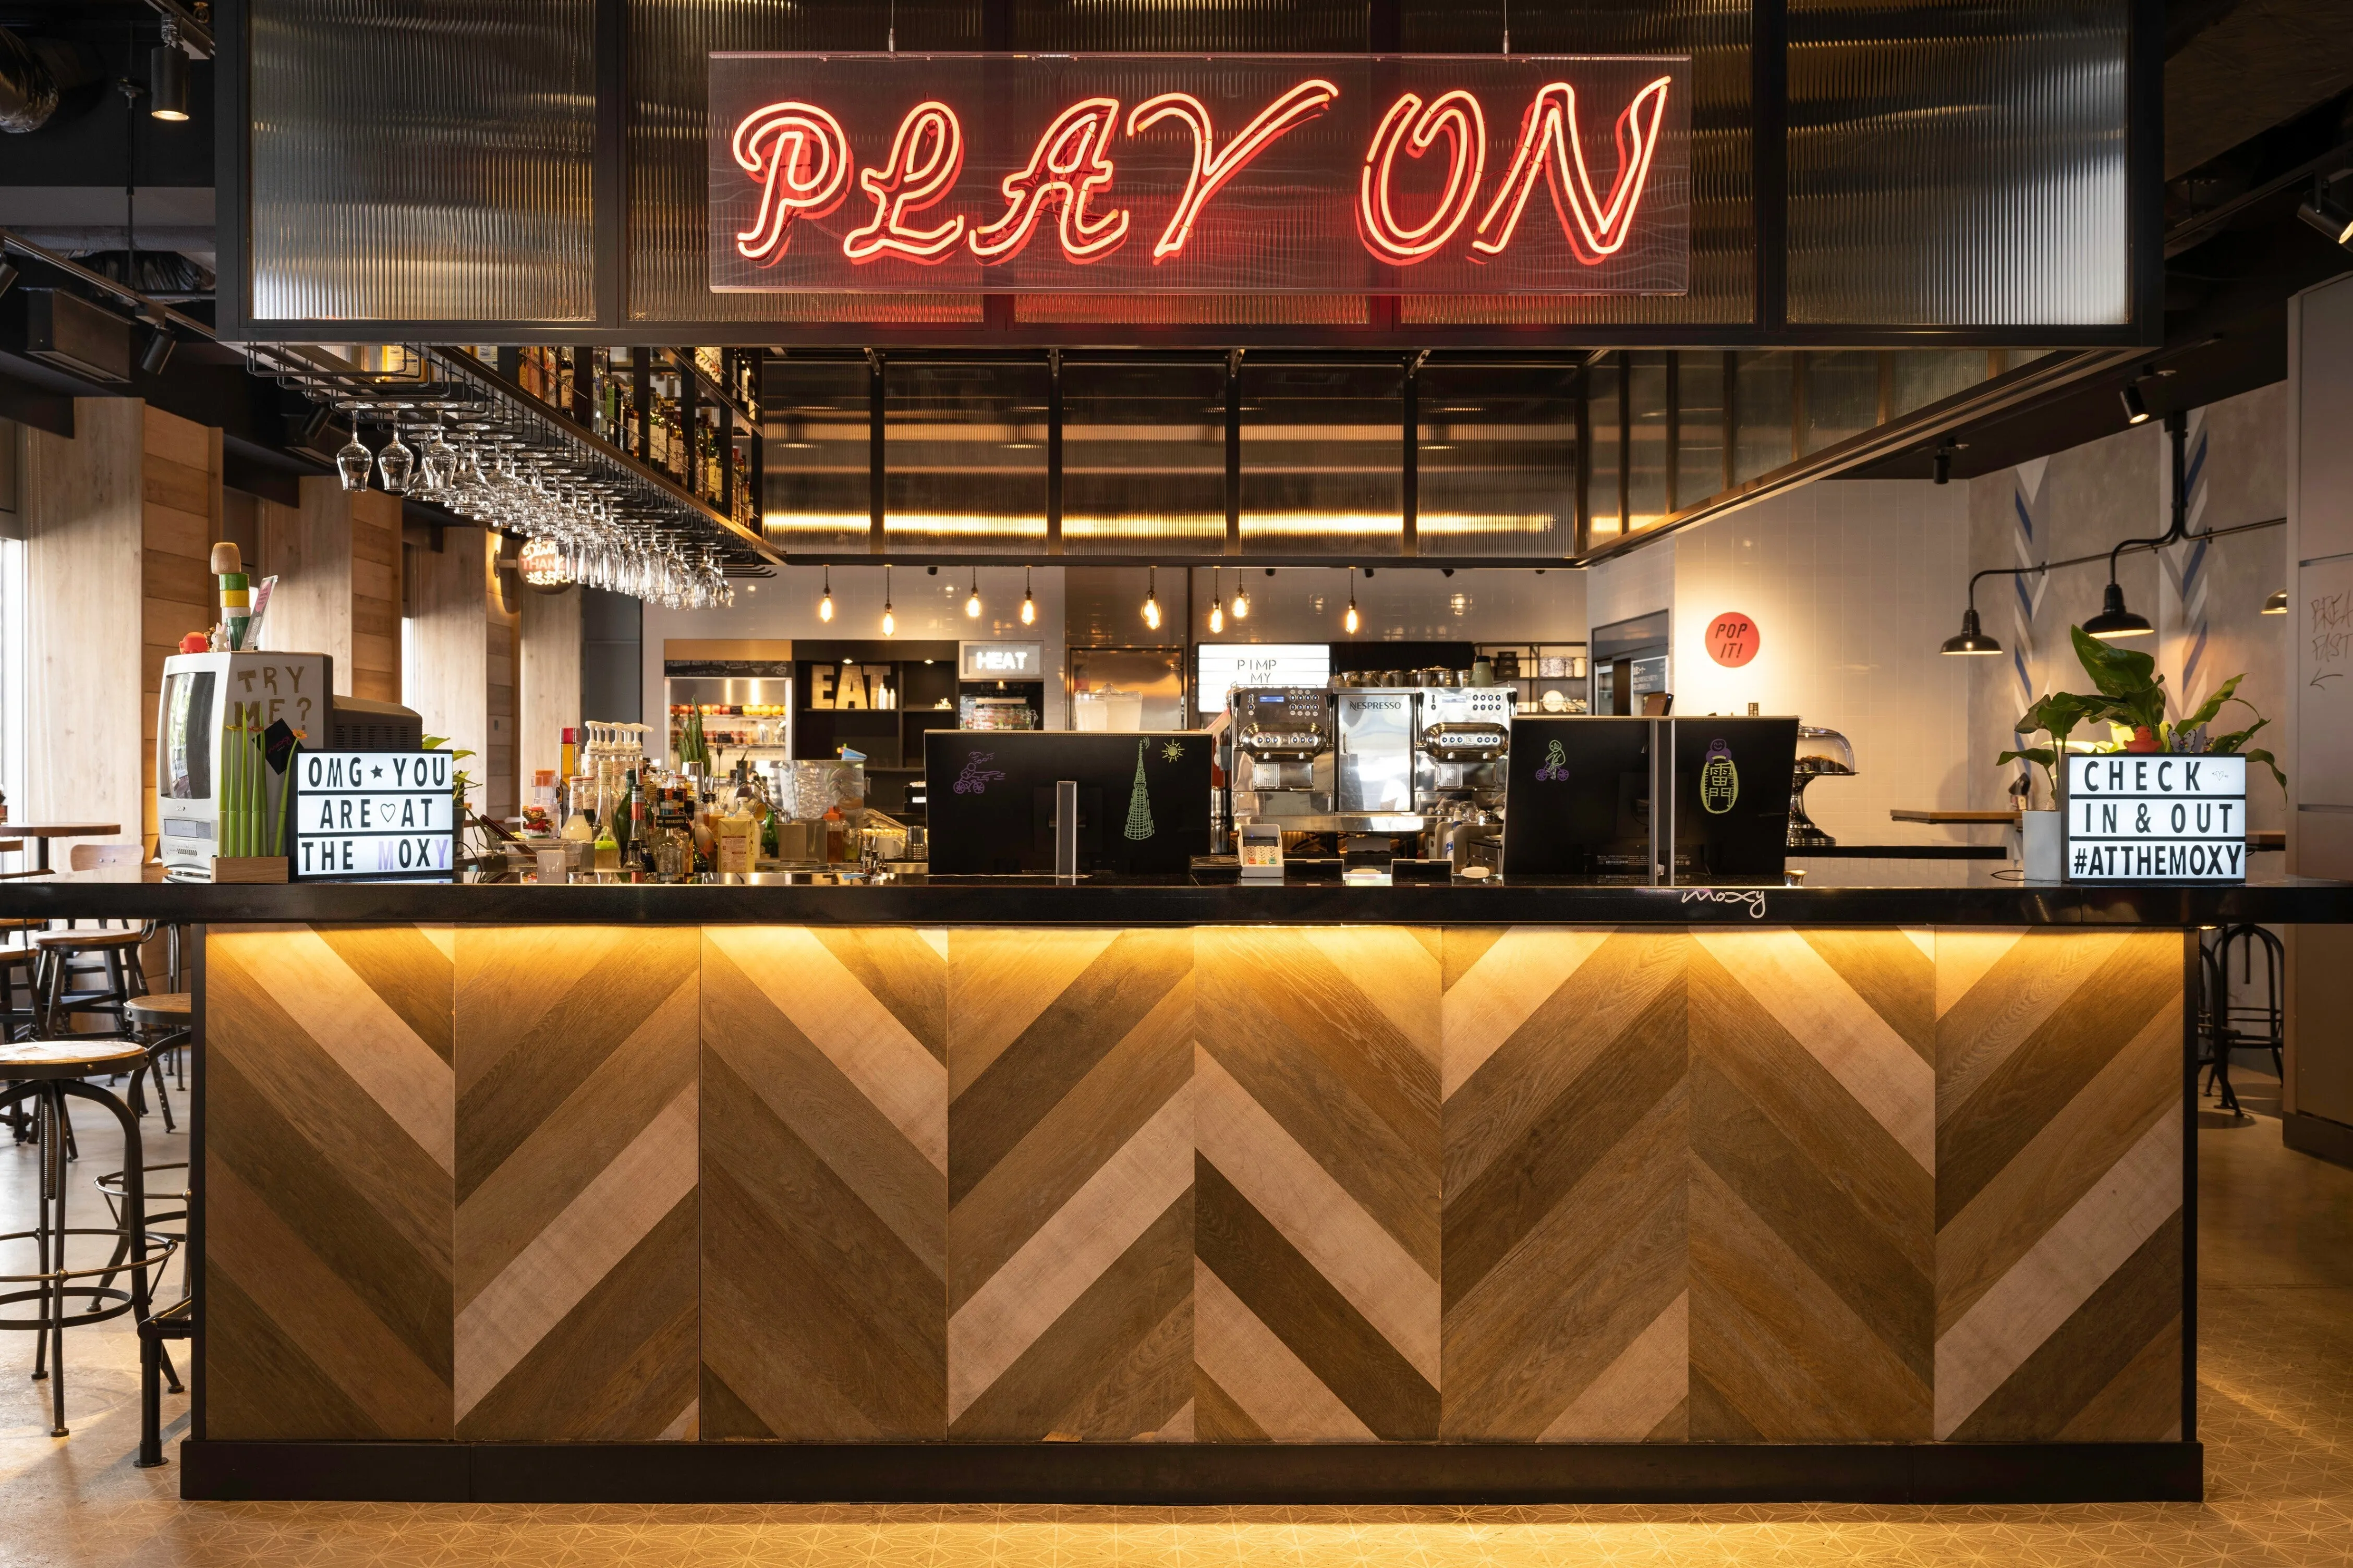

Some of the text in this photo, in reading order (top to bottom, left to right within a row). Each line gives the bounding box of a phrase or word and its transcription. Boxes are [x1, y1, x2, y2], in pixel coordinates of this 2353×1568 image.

[732, 75, 1671, 266] PLAY ON
[1715, 623, 1748, 638] POP
[976, 652, 1027, 670] HEAT
[1238, 660, 1277, 670] PIMP
[1720, 643, 1743, 658] IT!
[237, 666, 305, 695] TRY
[812, 665, 891, 709] EAT
[1251, 673, 1271, 683] MY
[1349, 700, 1401, 711] NESPRESSO
[308, 757, 445, 787] OMG YOU
[1708, 763, 1732, 807] 雷門
[2084, 761, 2201, 792] CHECK
[320, 798, 432, 829] ARE AT
[2086, 803, 2233, 833] IN & OUT
[301, 838, 448, 871] THE MOXY
[2074, 845, 2241, 876] #ATTHEMOXY
